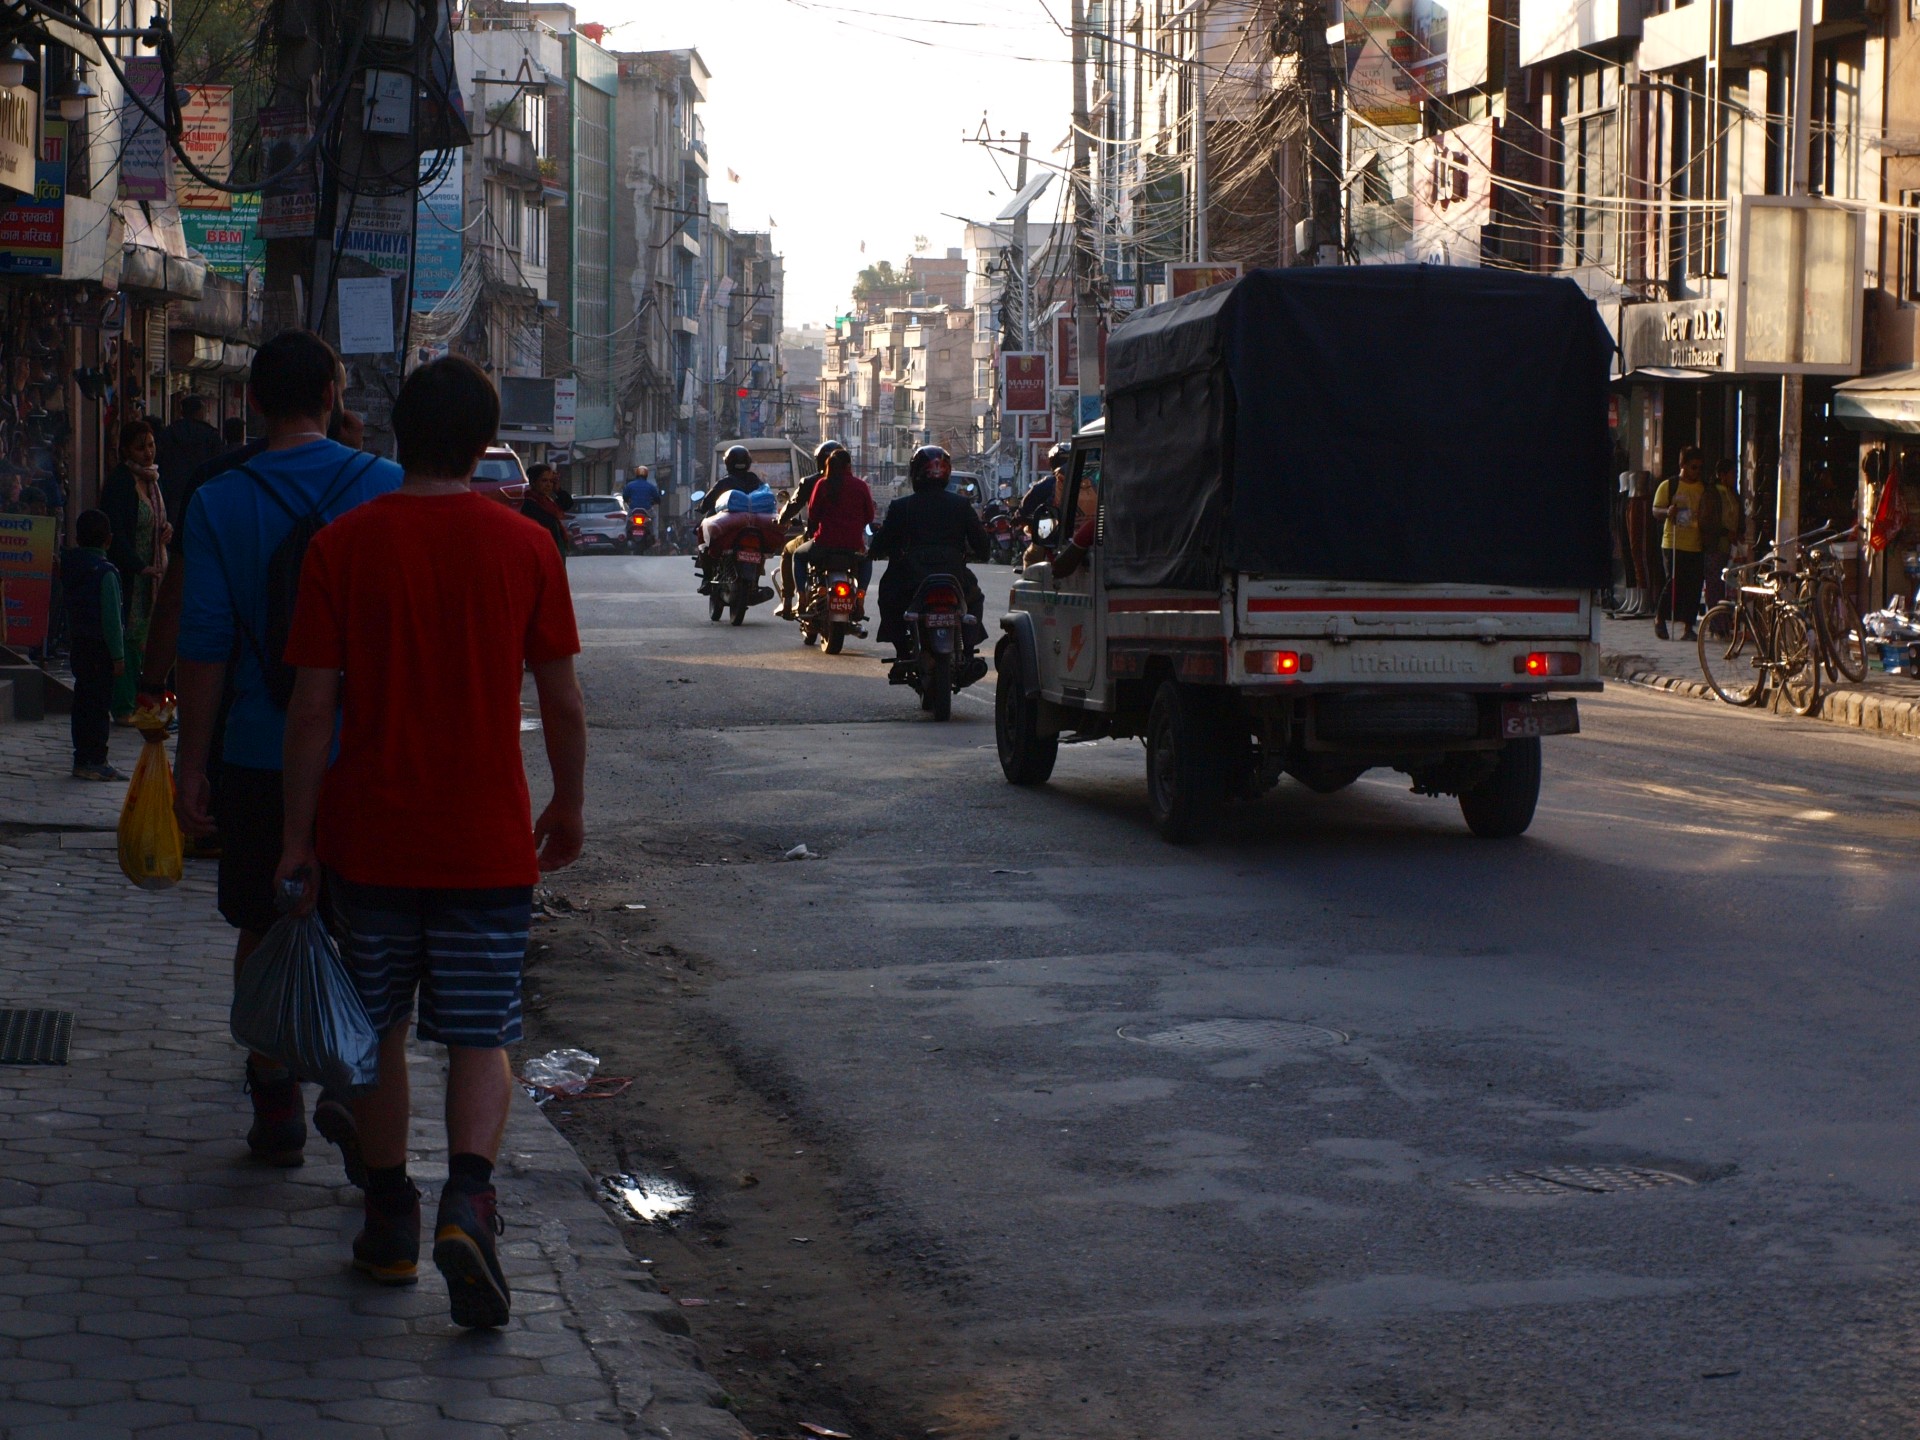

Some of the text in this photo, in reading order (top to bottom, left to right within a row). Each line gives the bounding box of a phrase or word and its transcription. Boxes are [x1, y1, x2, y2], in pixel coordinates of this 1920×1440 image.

[0, 89, 29, 149] PTICAL
[186, 142, 217, 152] PRODUCT
[202, 213, 231, 223] following
[206, 230, 242, 243] BBM
[368, 251, 409, 271] Hostel
[1661, 311, 1688, 342] New
[1670, 346, 1719, 367] Dillibazar
[1008, 379, 1044, 388] MARUTI
[1351, 654, 1478, 675] Mahindra
